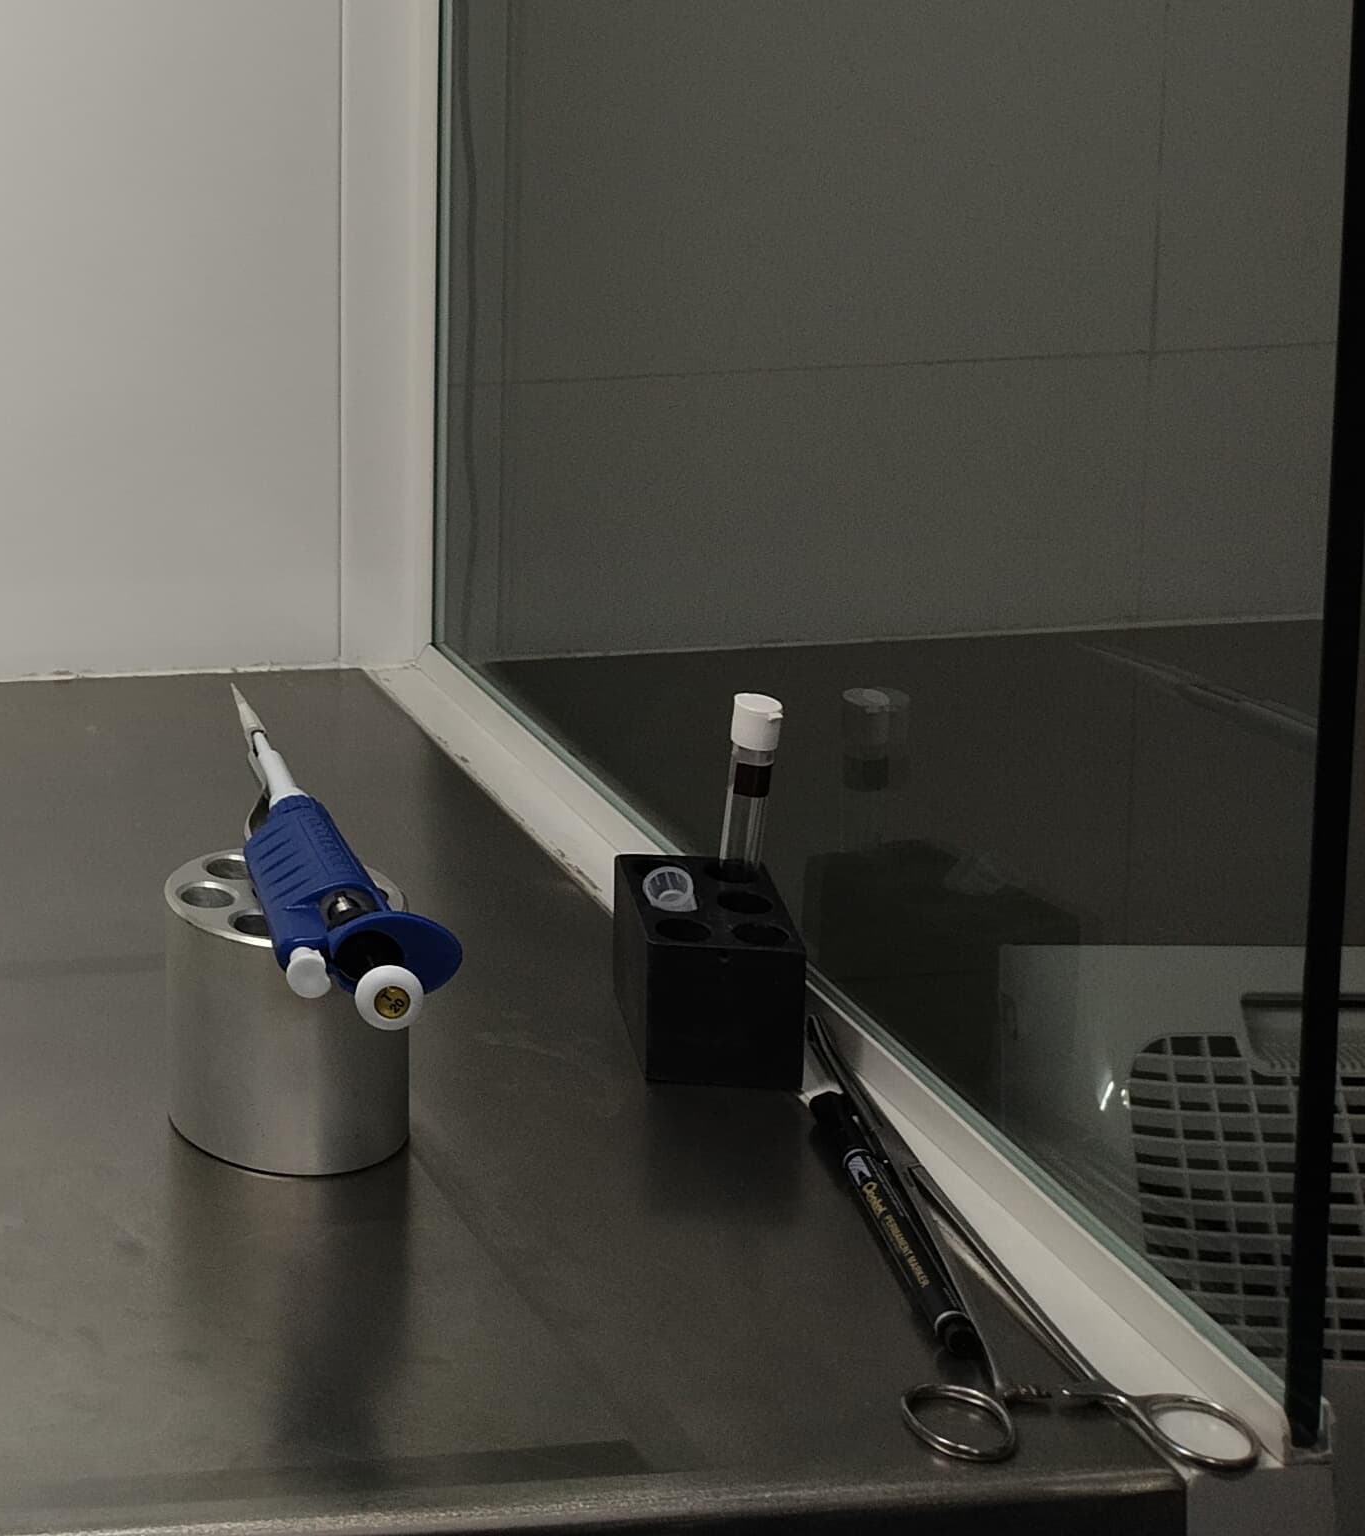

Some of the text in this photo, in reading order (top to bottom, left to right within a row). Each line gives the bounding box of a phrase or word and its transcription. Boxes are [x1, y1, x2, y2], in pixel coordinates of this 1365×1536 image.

[388, 998, 406, 1014] 20
[884, 1214, 914, 1257] PERMANENT
[907, 1255, 930, 1289] MARKER
